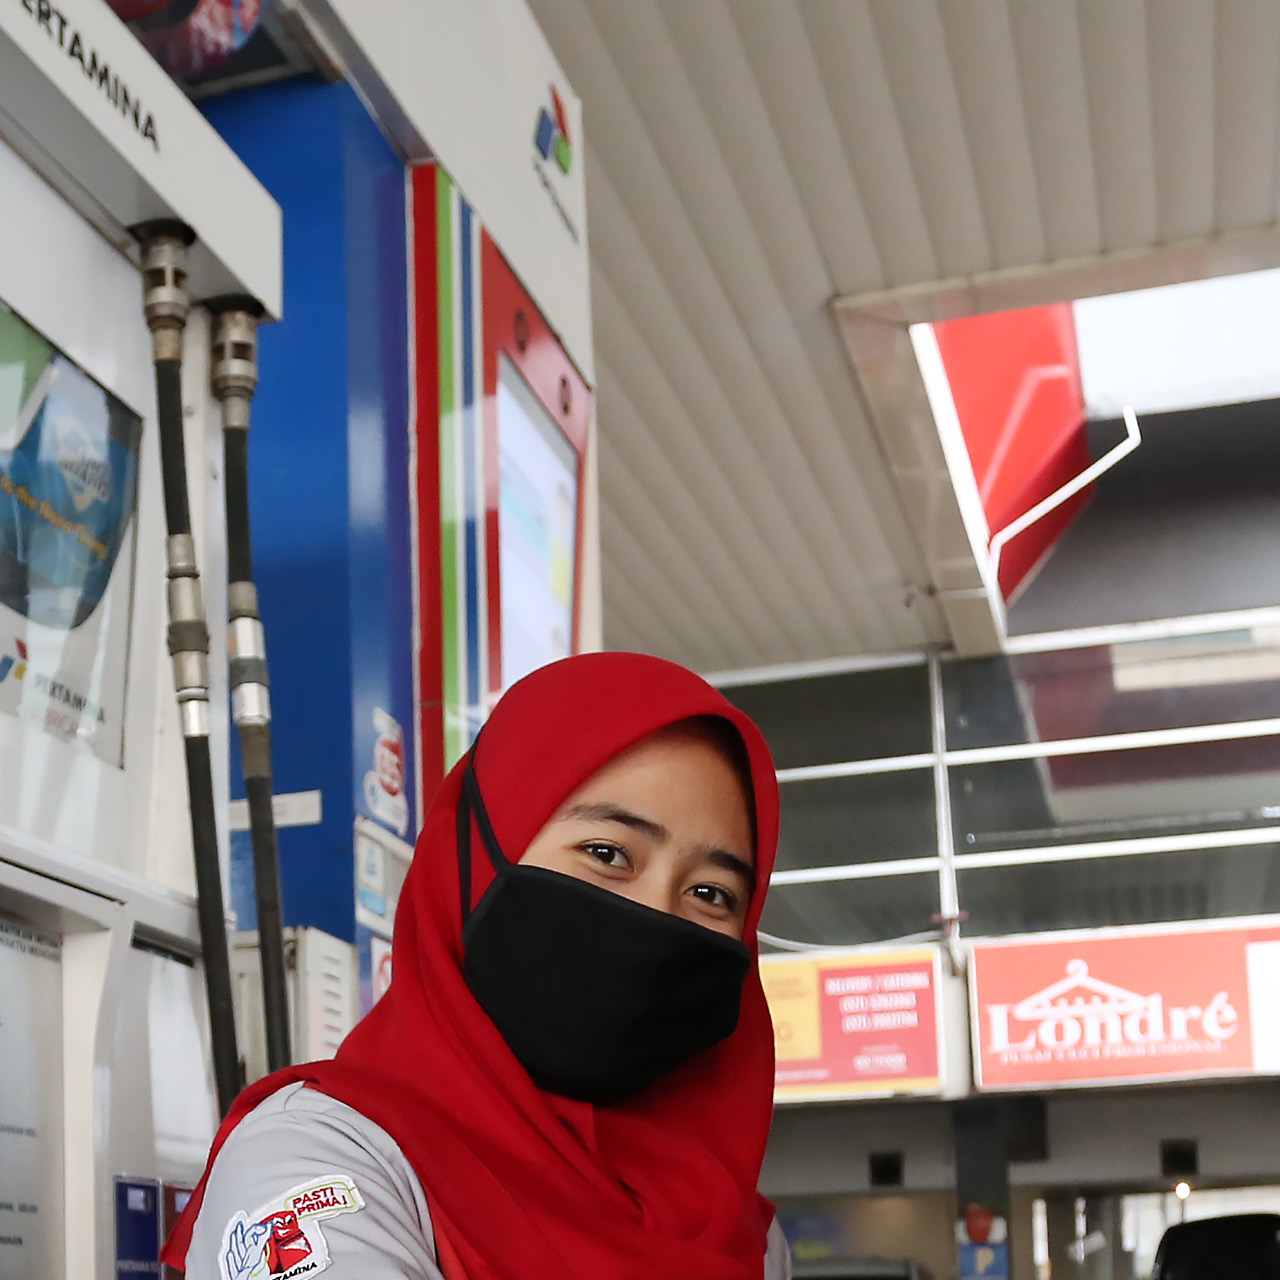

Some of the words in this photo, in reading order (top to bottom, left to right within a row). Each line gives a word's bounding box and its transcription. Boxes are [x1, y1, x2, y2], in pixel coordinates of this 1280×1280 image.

[22, 0, 160, 152] RTAMINA
[34, 672, 106, 724] PERTAMIA
[986, 990, 1240, 1053] Londré
[292, 1186, 334, 1209] PASTI
